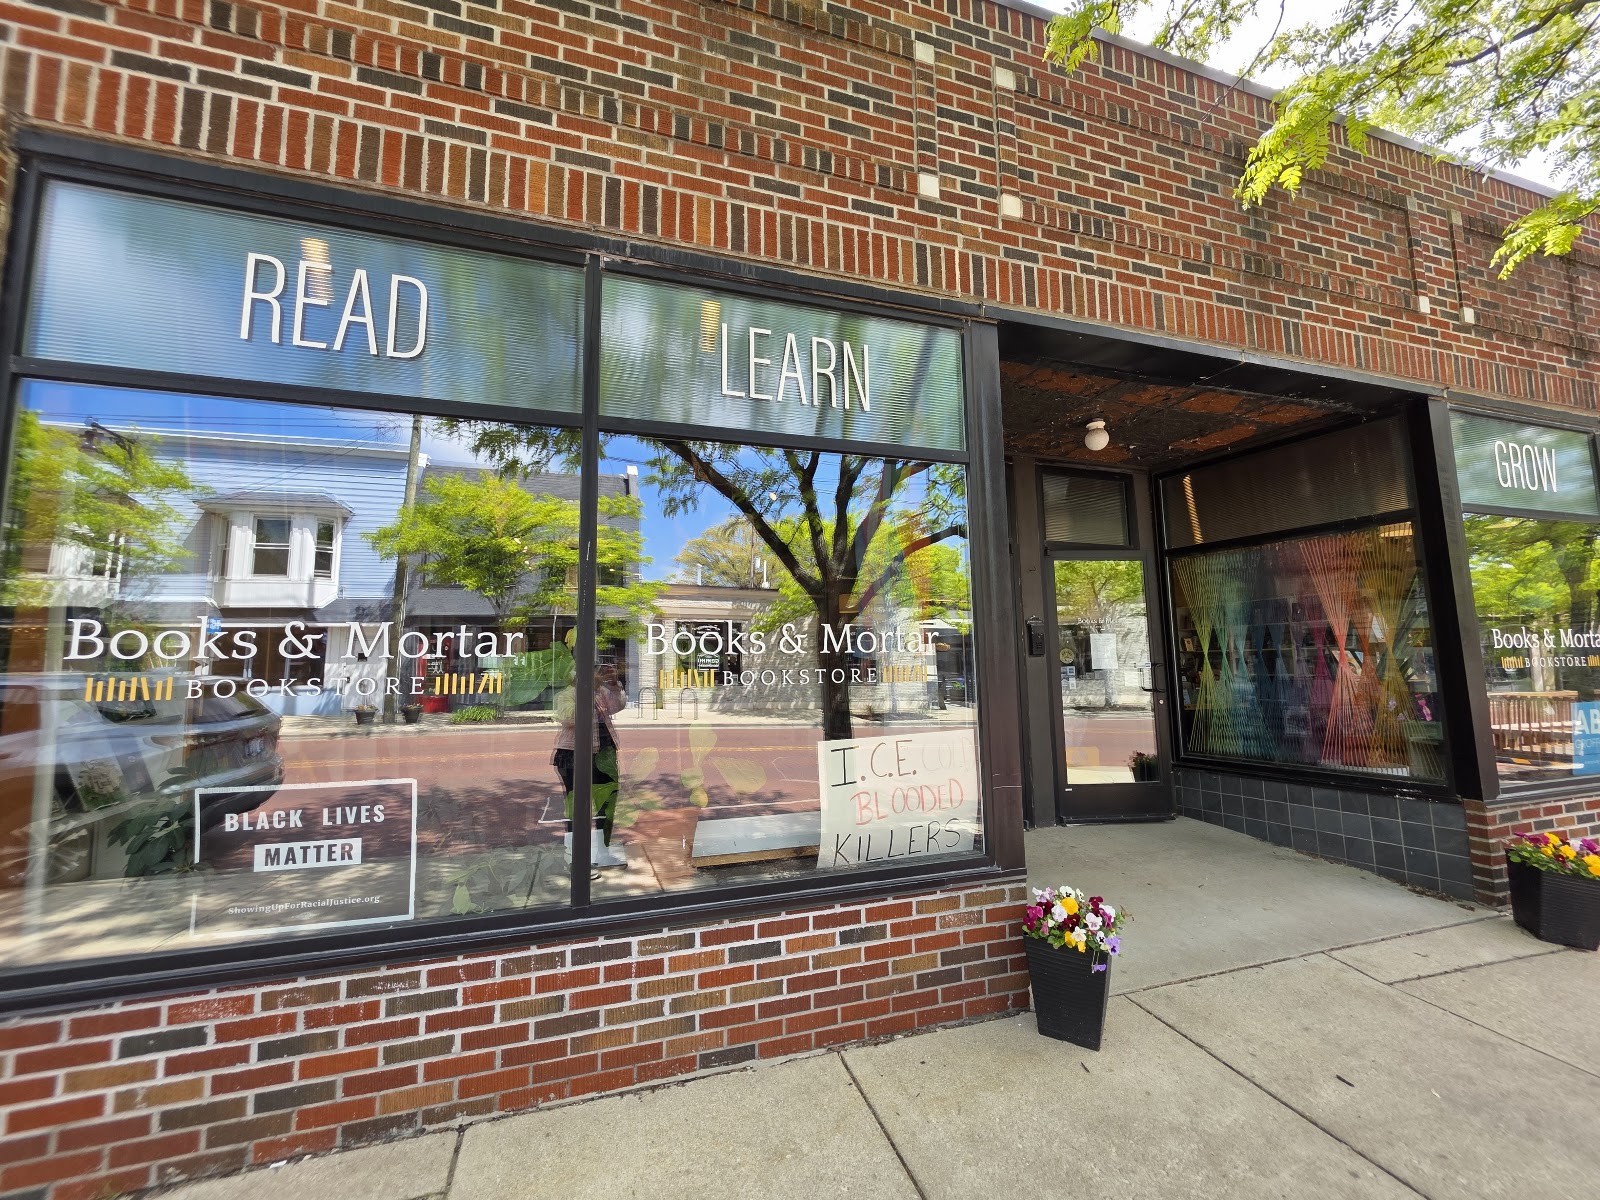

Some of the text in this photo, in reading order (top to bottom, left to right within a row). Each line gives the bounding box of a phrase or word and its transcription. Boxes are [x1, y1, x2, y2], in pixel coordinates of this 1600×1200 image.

[240, 252, 428, 359] READ
[721, 323, 870, 411] LEARN
[1494, 440, 1557, 492] GROW
[63, 615, 523, 660] Books & Mortar
[645, 620, 939, 655] Books & Mortar
[1491, 626, 1540, 649] Books
[1543, 628, 1556, 648] &
[723, 667, 877, 687] BOOKSTORE
[1525, 656, 1587, 668] BOOKSTORE
[185, 676, 425, 699] BOOKSTORE
[831, 739, 917, 787] I.C.E.
[225, 804, 385, 832] BLACK LIVES
[850, 778, 964, 825] BLOODED
[264, 843, 354, 867] MATTER
[833, 818, 961, 867] KILLERS
[228, 895, 381, 914] ShowingUpForRacialJustice.org
